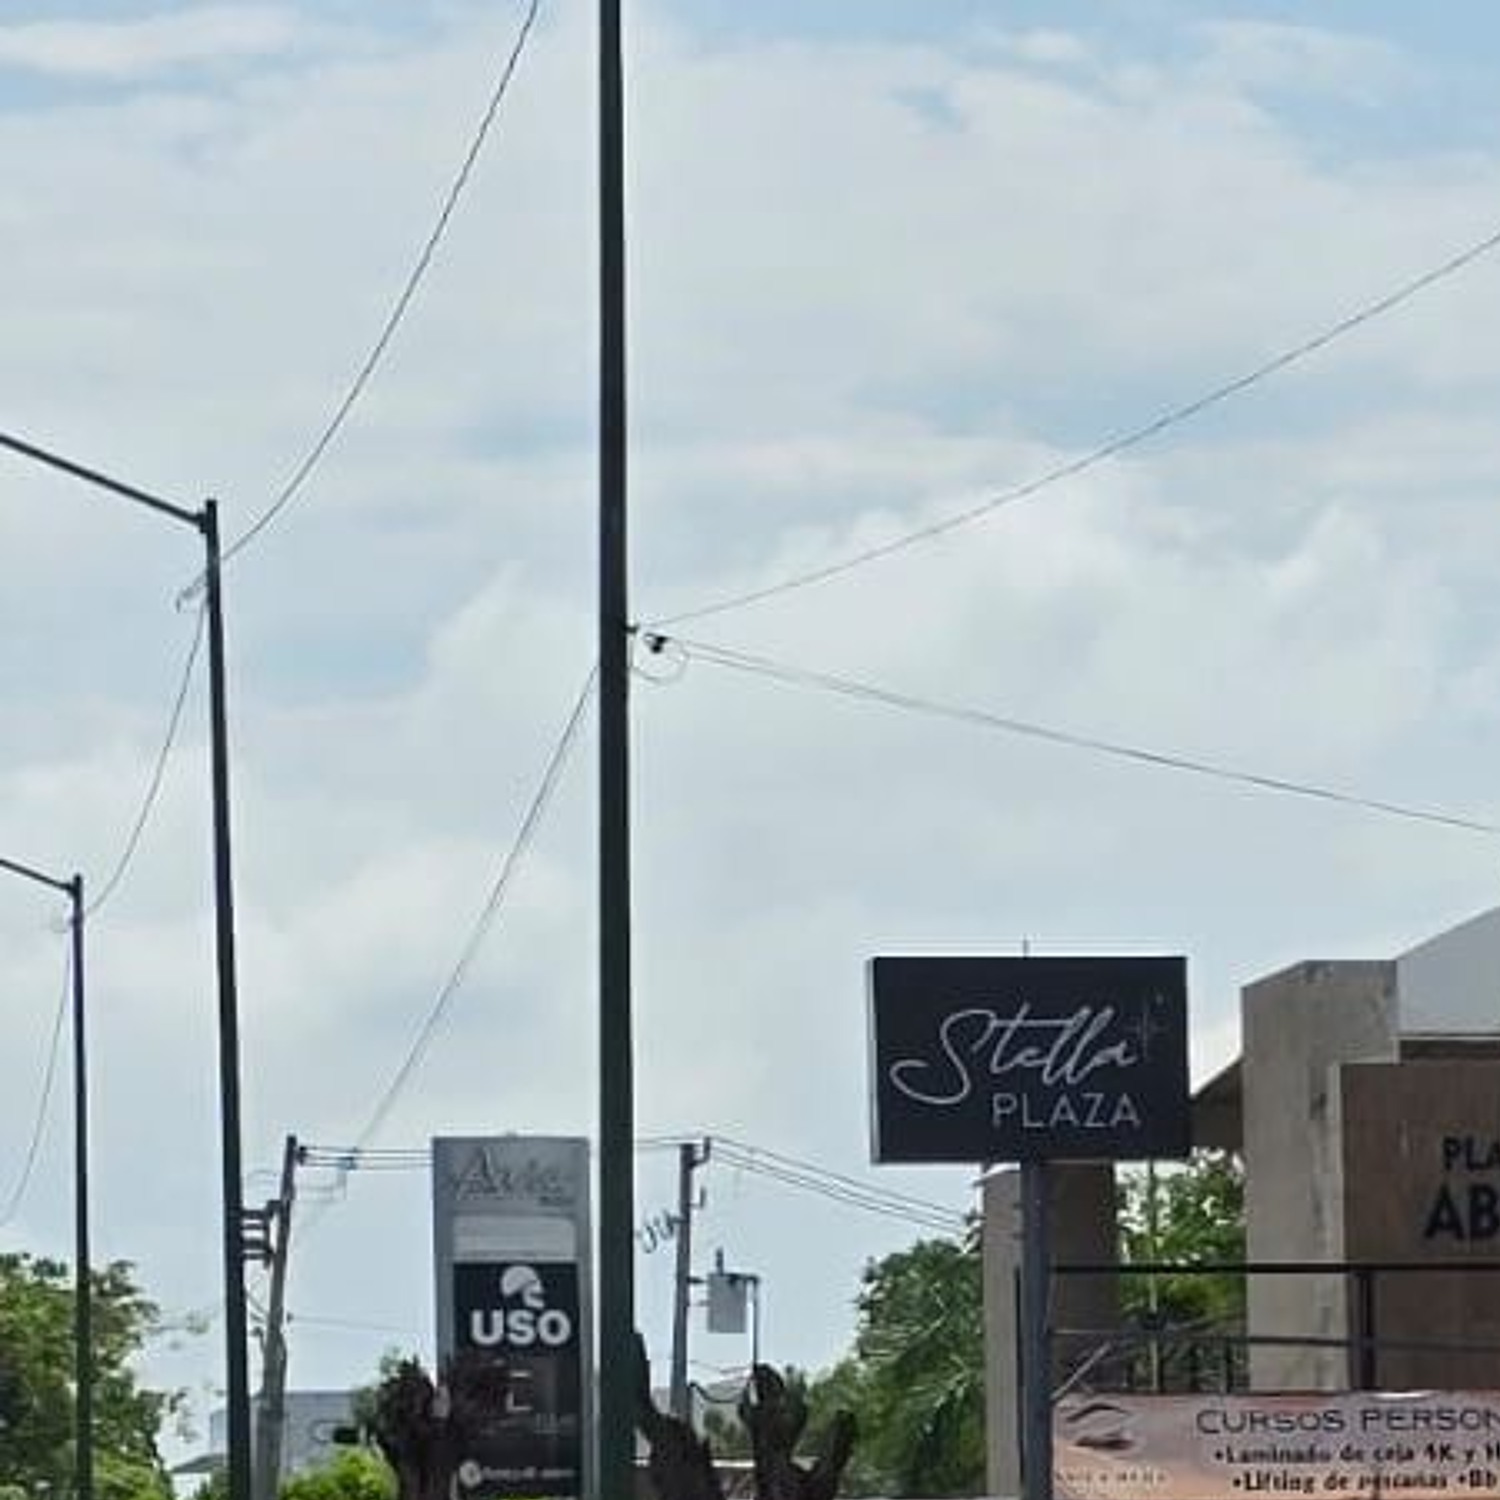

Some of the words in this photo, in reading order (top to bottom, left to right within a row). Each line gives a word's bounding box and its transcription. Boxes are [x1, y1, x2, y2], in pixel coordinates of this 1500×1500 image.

[889, 1001, 1139, 1104] Stella
[992, 1092, 1141, 1129] PLAZA
[470, 1308, 571, 1346] USO
[1196, 1409, 1345, 1434] CURSOS
[1339, 1444, 1366, 1463] de
[1462, 1450, 1476, 1464] y
[1243, 1471, 1315, 1494] Lifting
[1323, 1471, 1349, 1490] de
